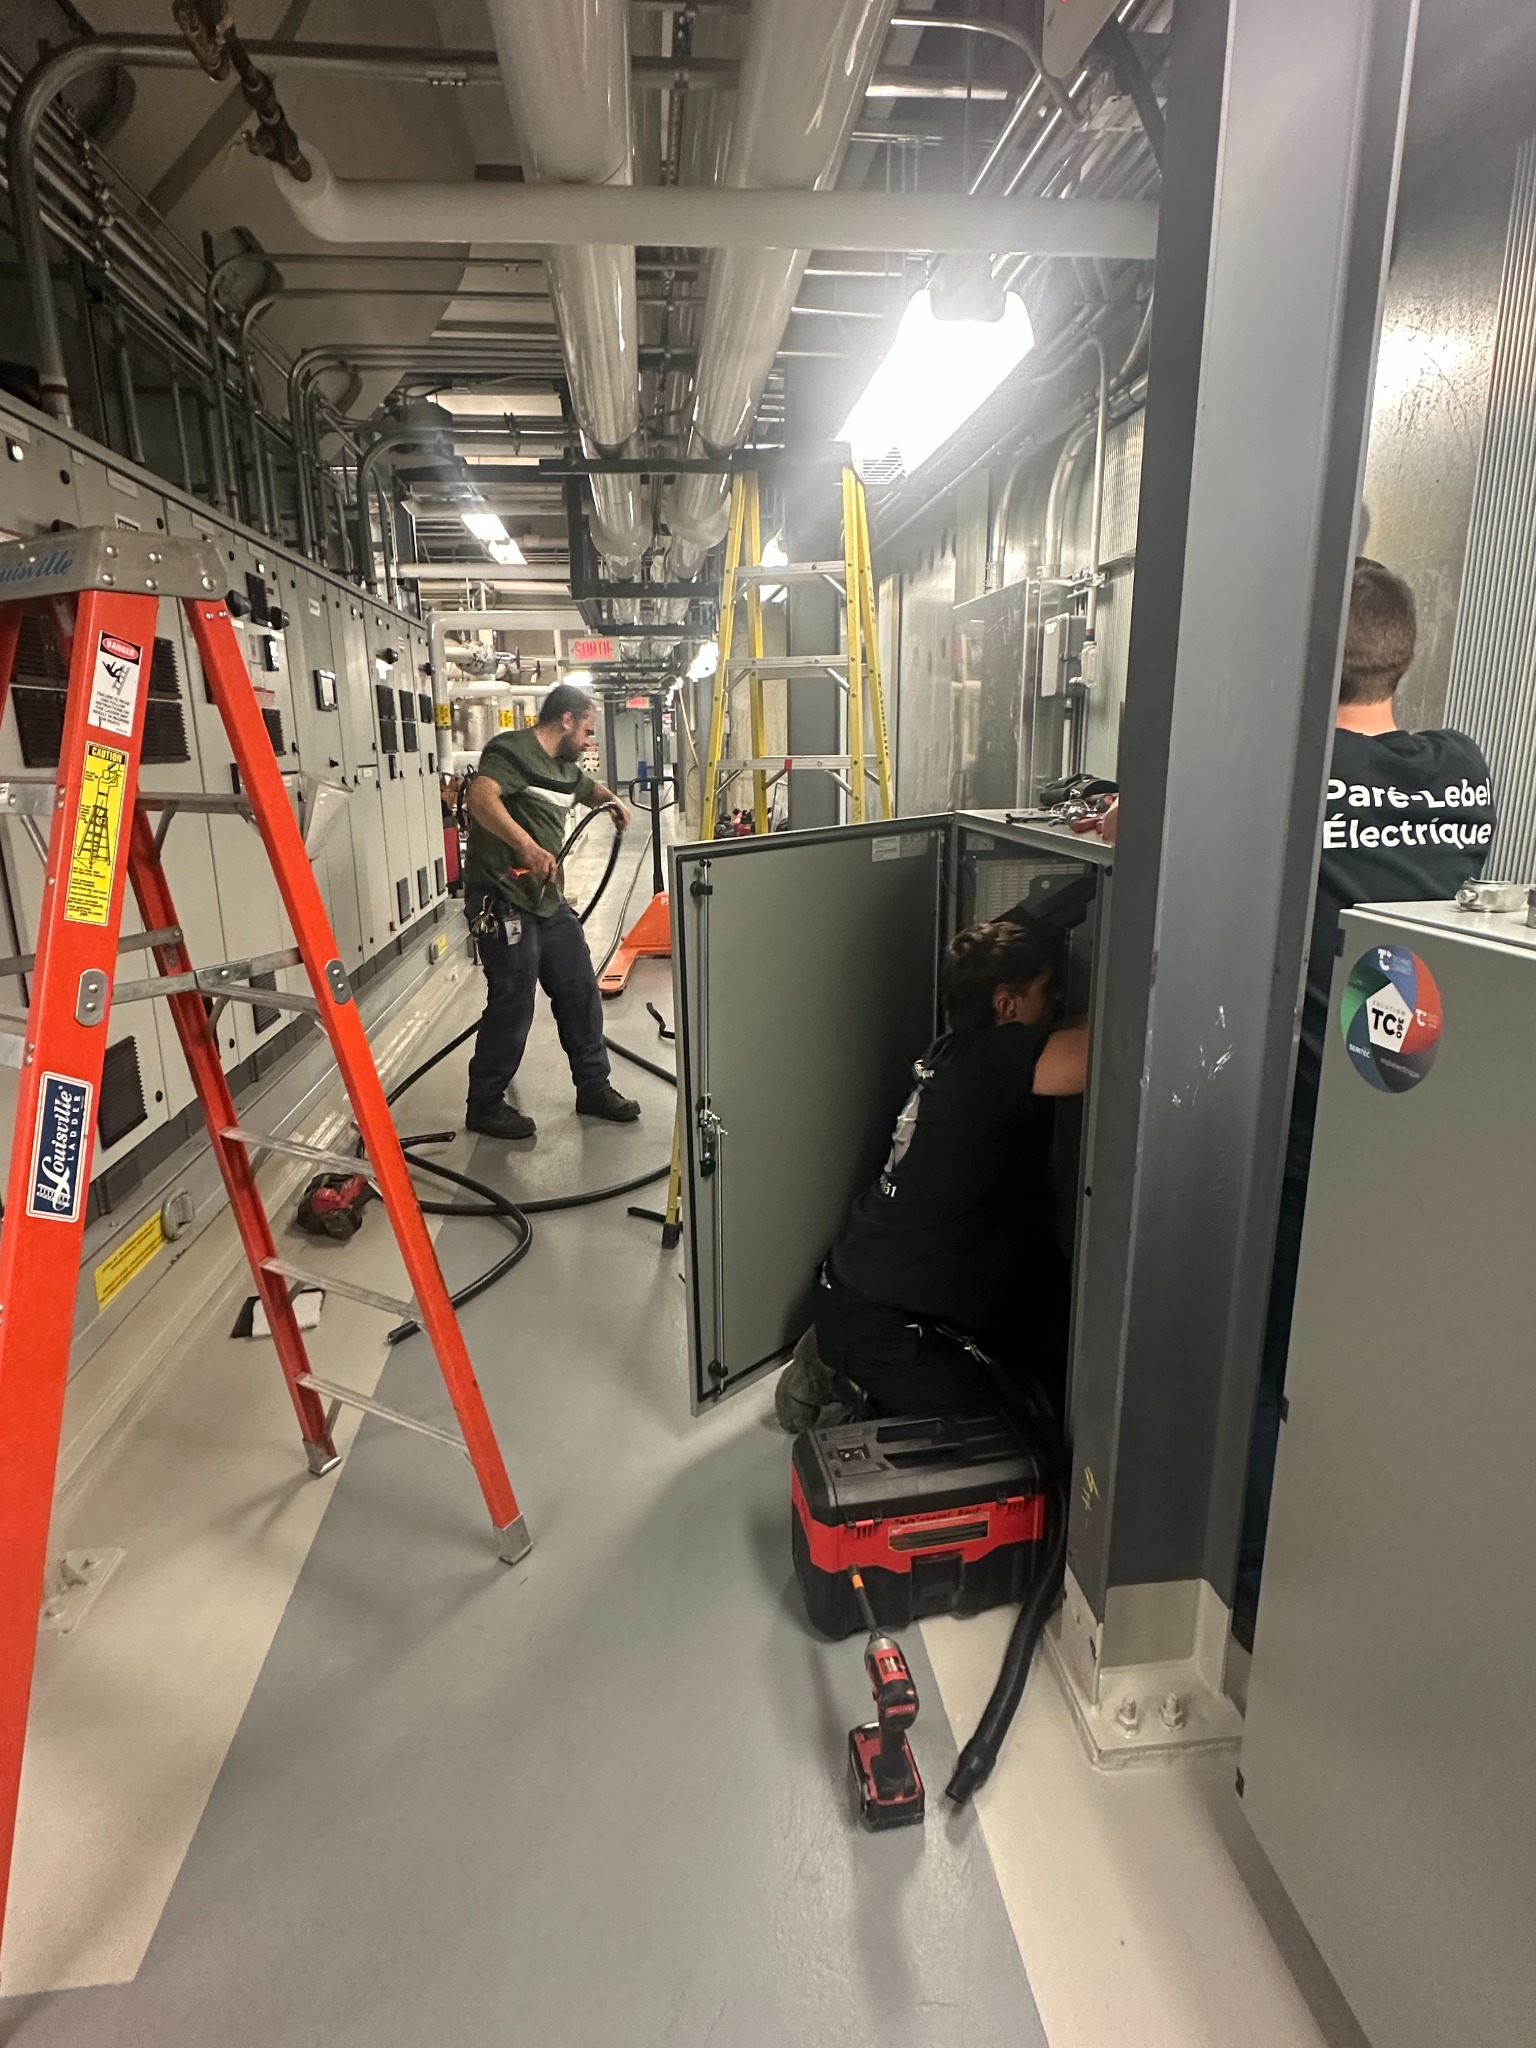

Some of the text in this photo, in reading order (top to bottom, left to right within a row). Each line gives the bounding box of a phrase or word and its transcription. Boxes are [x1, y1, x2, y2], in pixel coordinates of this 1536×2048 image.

[106, 640, 136, 658] DANGER
[574, 640, 614, 660] SORTIE
[91, 746, 123, 764] CAUTION
[1322, 813, 1492, 849] Électrique
[1372, 1008, 1397, 1036] TC
[67, 1095, 82, 1161] LADDER
[42, 1090, 73, 1211] Louisville
